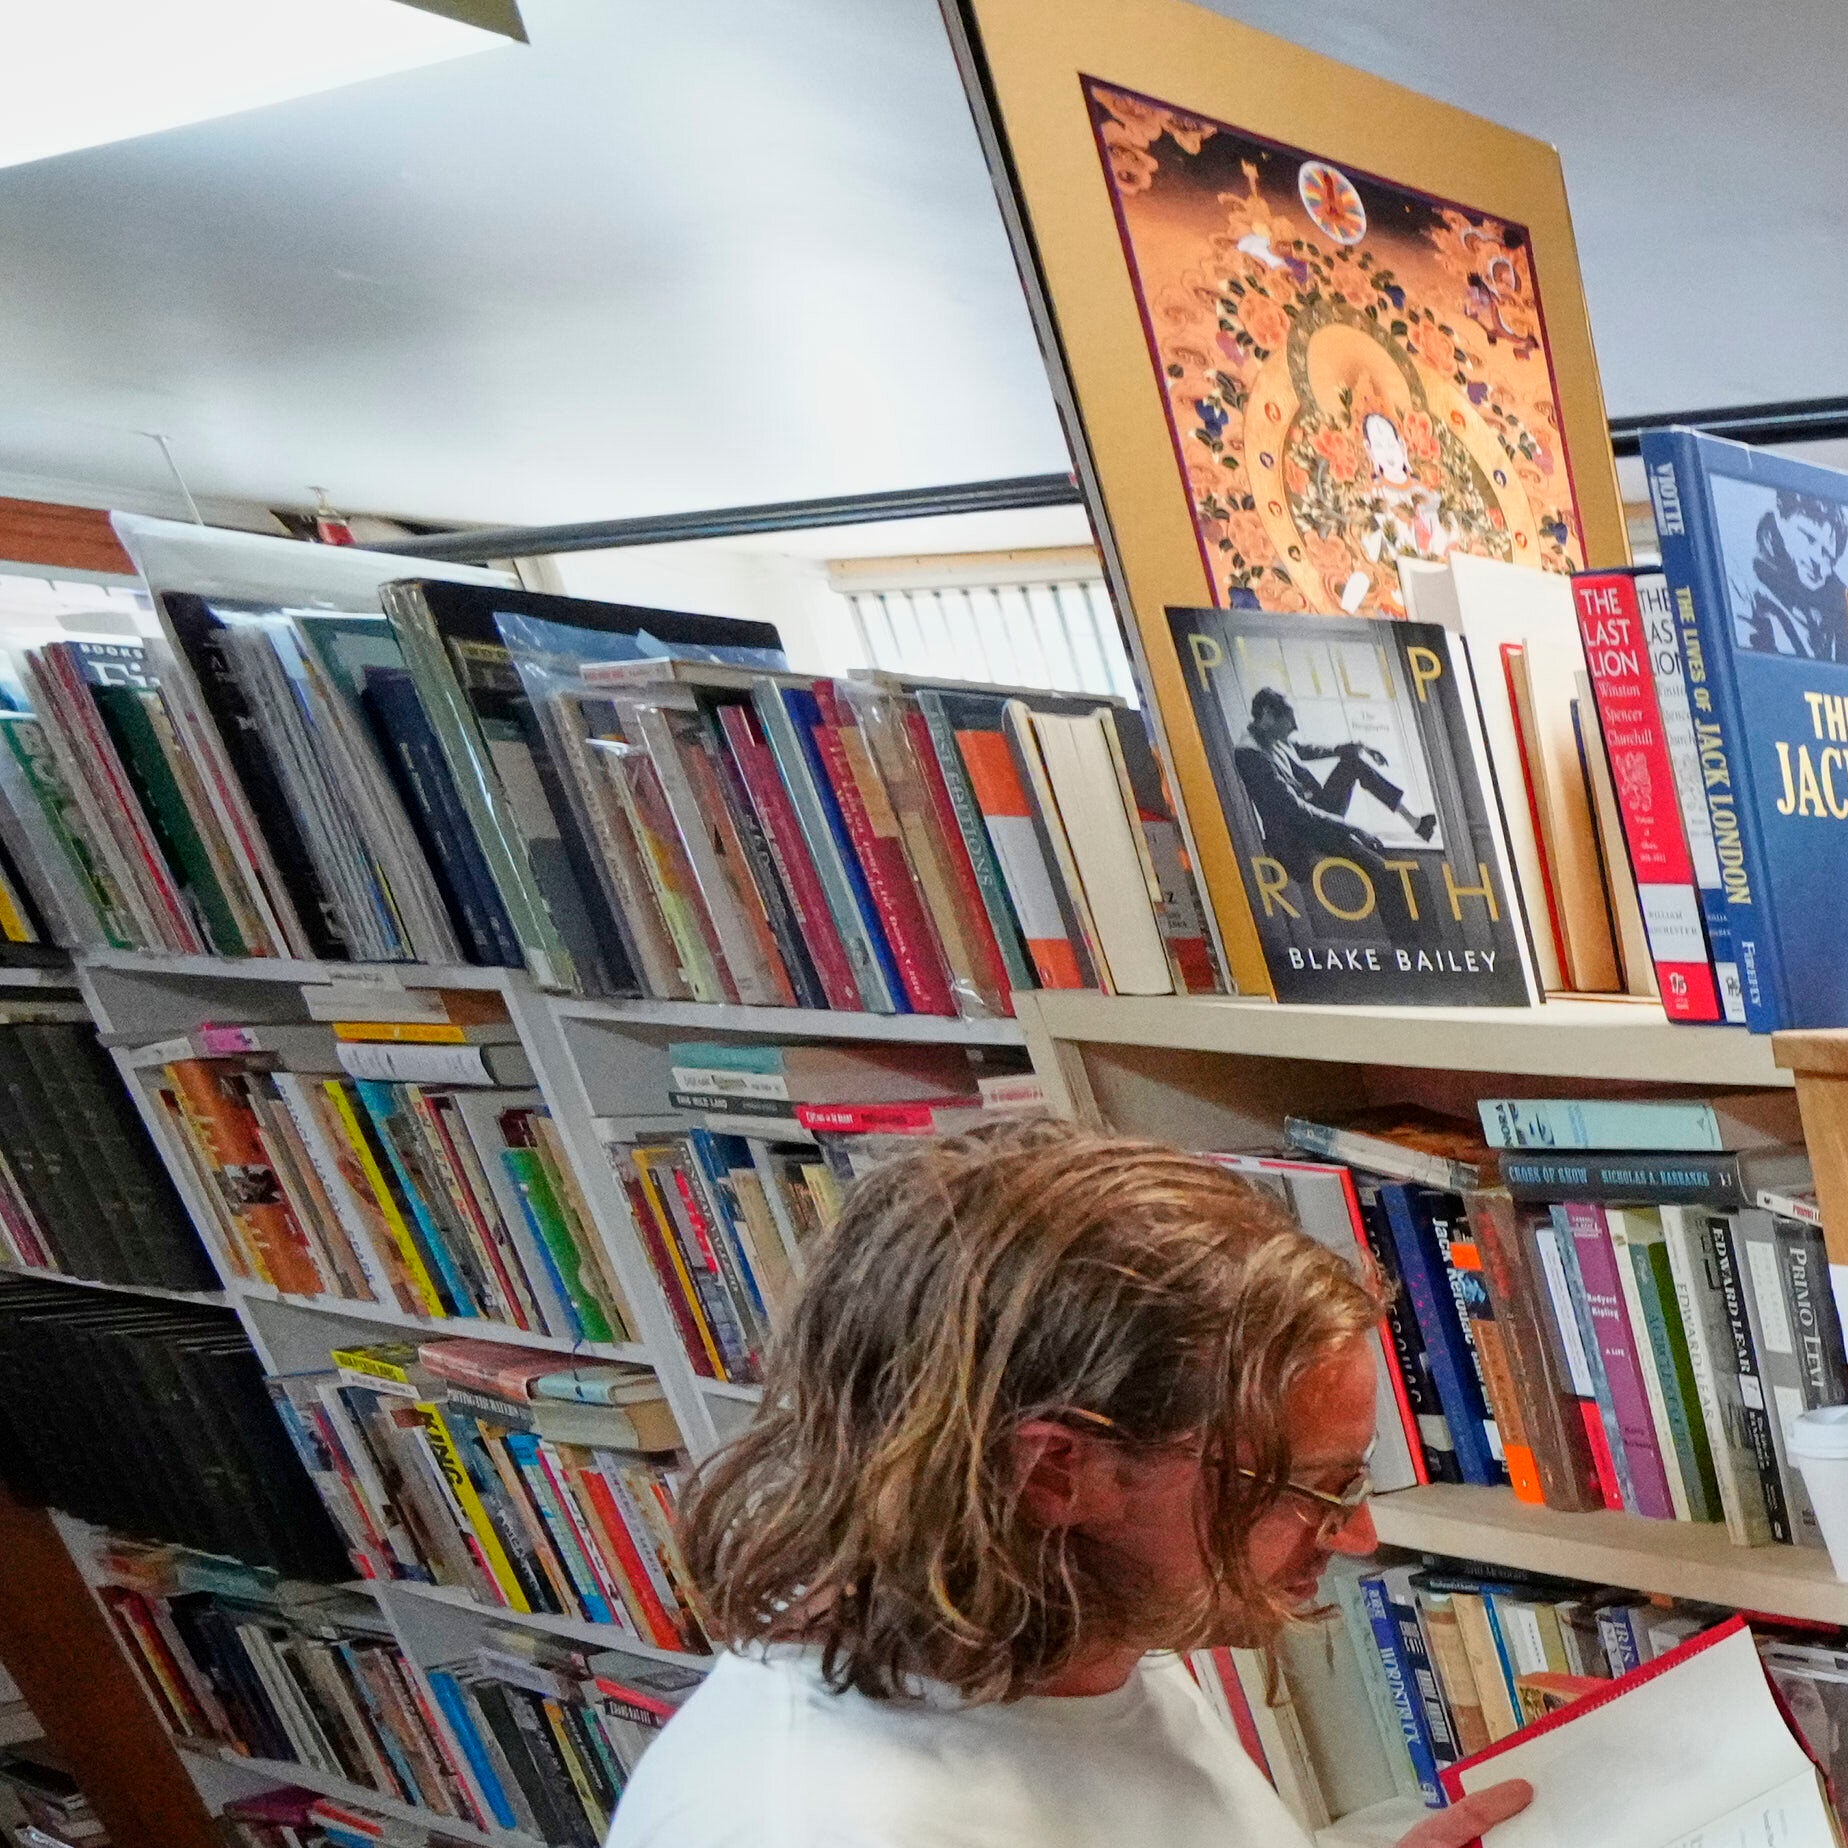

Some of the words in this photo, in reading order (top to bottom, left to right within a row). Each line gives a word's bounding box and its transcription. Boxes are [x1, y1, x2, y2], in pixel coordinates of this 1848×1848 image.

[1582, 586, 1622, 617] THE
[1675, 585, 1696, 623] THE
[1584, 619, 1631, 648] LAST
[1683, 629, 1707, 682] LIVES
[1188, 633, 1442, 705] PHILIP
[1588, 650, 1640, 678] LION
[1604, 706, 1643, 725] Spencer
[1694, 688, 1711, 712] OF
[1606, 728, 1653, 748] Churchill
[1698, 722, 1730, 789] JACK
[1709, 793, 1751, 905] LONDON
[1251, 857, 1501, 923] ROTH
[1289, 946, 1381, 973] BLAKE
[1395, 948, 1498, 974] BAILEY
[1430, 1214, 1458, 1263] Jack
[1445, 1265, 1481, 1344] Kerouac
[1706, 1227, 1743, 1319] EDWARD
[1727, 1320, 1754, 1374] LEAR
[1788, 1244, 1817, 1327] PRIMO
[1669, 1281, 1707, 1369] EDWARD
[1691, 1369, 1718, 1420] LEAR
[1802, 1333, 1826, 1389] LEVI
[412, 1408, 472, 1487] KING
